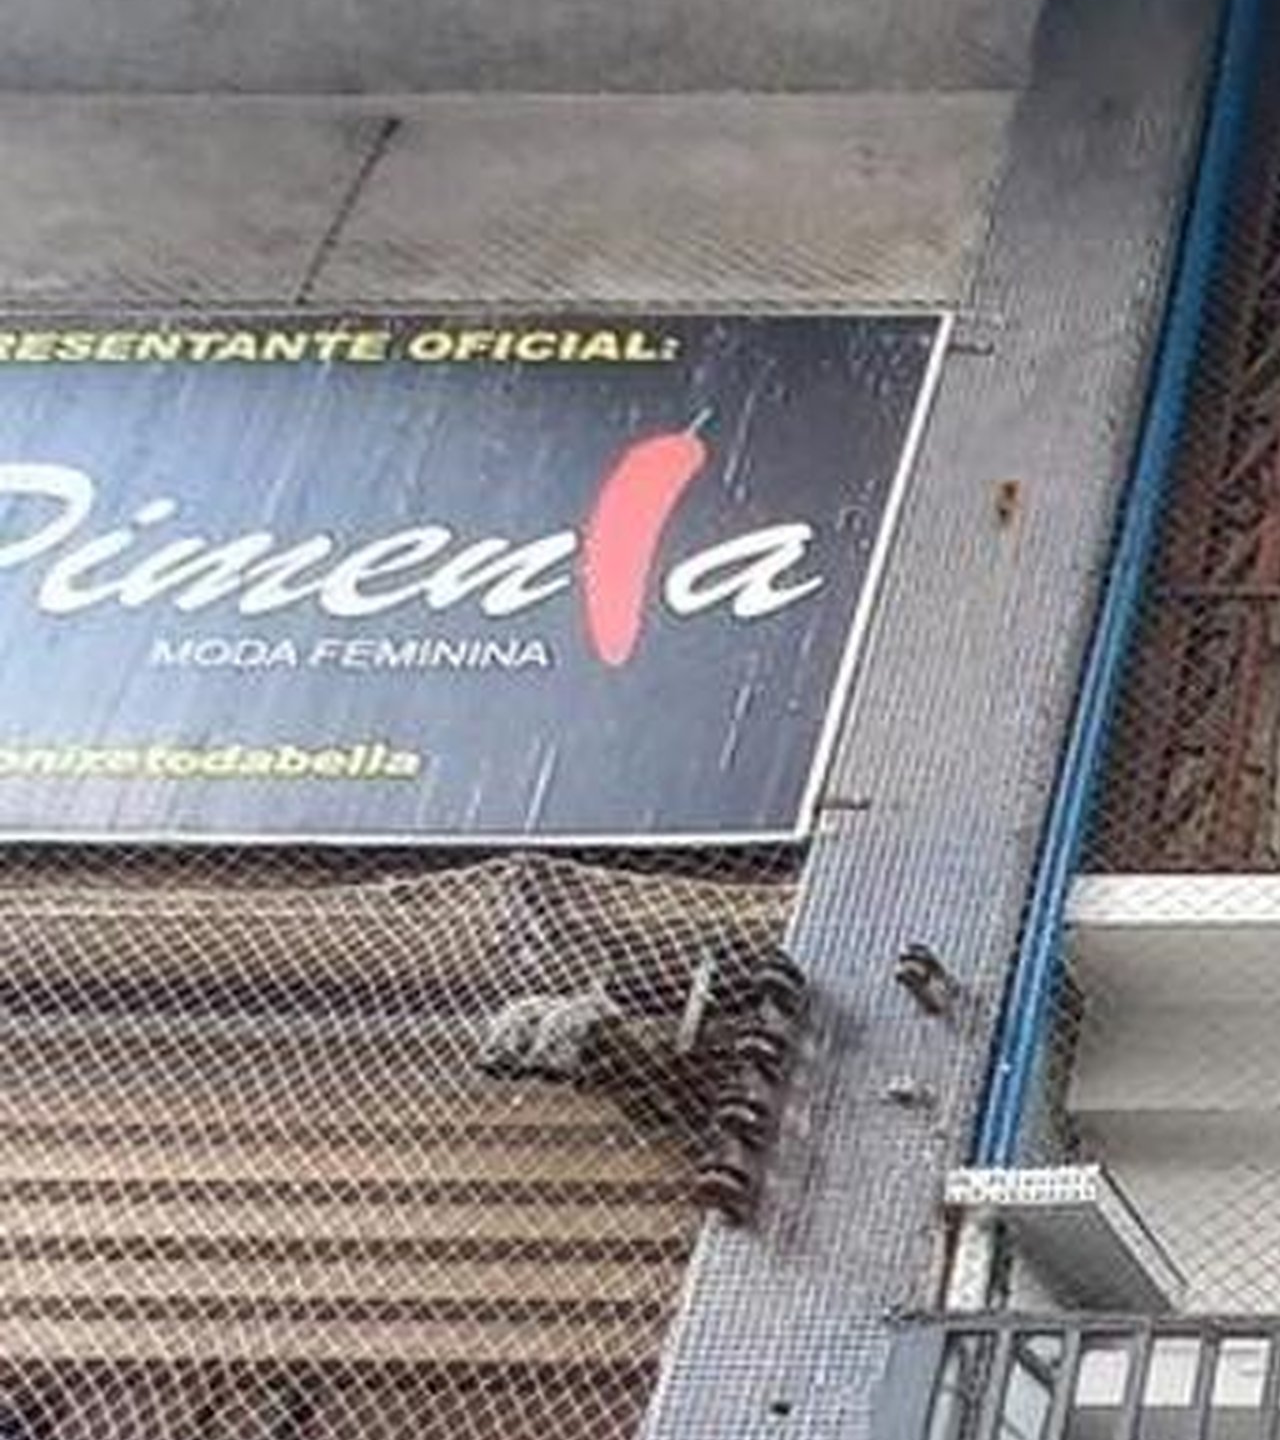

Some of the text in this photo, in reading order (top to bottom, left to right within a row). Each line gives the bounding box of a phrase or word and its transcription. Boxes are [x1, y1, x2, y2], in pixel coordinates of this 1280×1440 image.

[408, 329, 681, 362] OFICIAL:
[151, 637, 551, 668] MODA FEMININA
